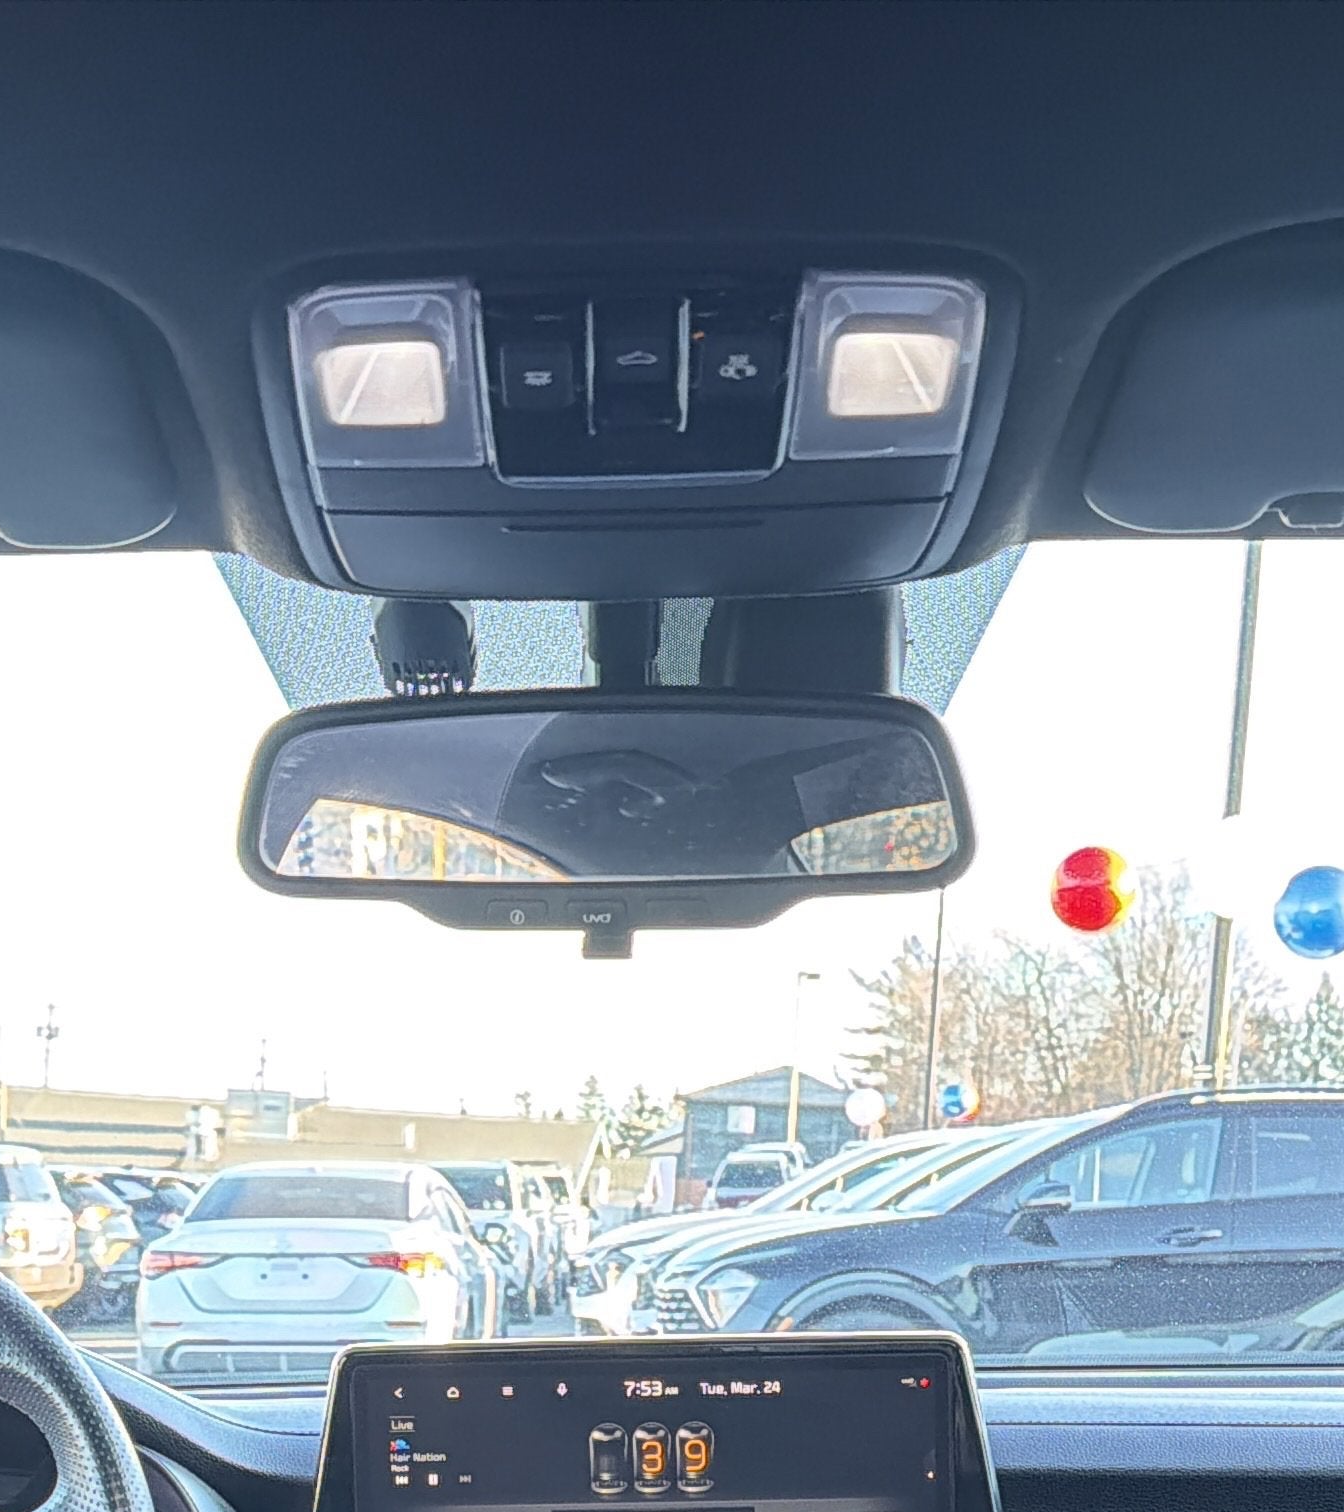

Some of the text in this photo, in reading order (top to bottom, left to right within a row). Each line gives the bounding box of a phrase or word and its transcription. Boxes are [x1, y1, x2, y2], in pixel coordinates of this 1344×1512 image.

[623, 1380, 679, 1397] 7:53 AM
[730, 1381, 761, 1395] Mar.
[763, 1380, 782, 1394] 24
[391, 1419, 414, 1430] Live
[389, 1452, 447, 1462] Hair Nation
[390, 1464, 410, 1472] Rock
